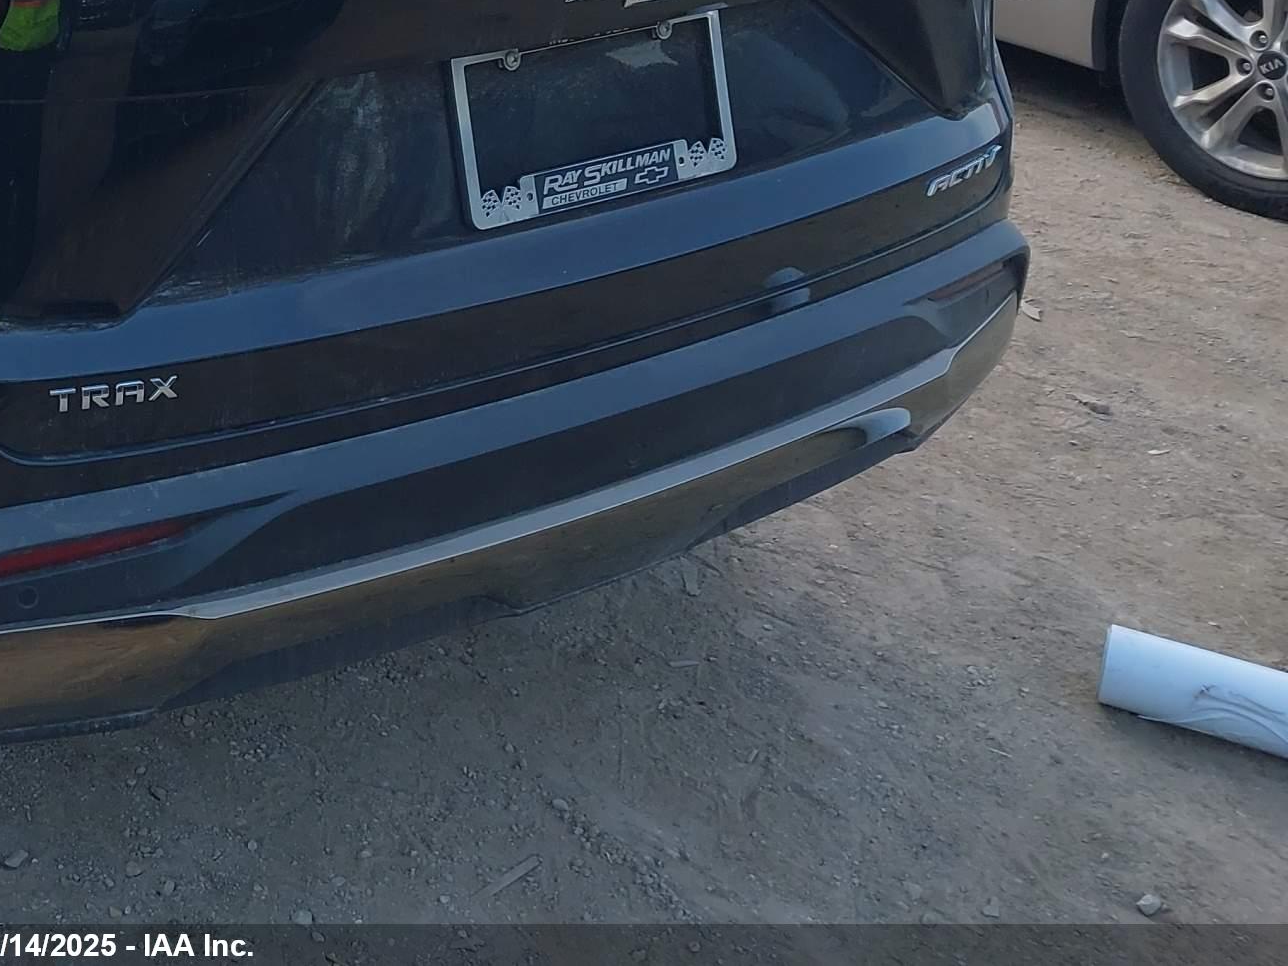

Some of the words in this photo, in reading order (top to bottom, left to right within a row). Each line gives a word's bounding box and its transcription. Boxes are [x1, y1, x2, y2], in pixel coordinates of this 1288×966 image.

[543, 172, 585, 195] RAY
[584, 148, 672, 186] SKILLMAN
[551, 183, 619, 207] CHEVROLET
[49, 375, 179, 413] TRAX
